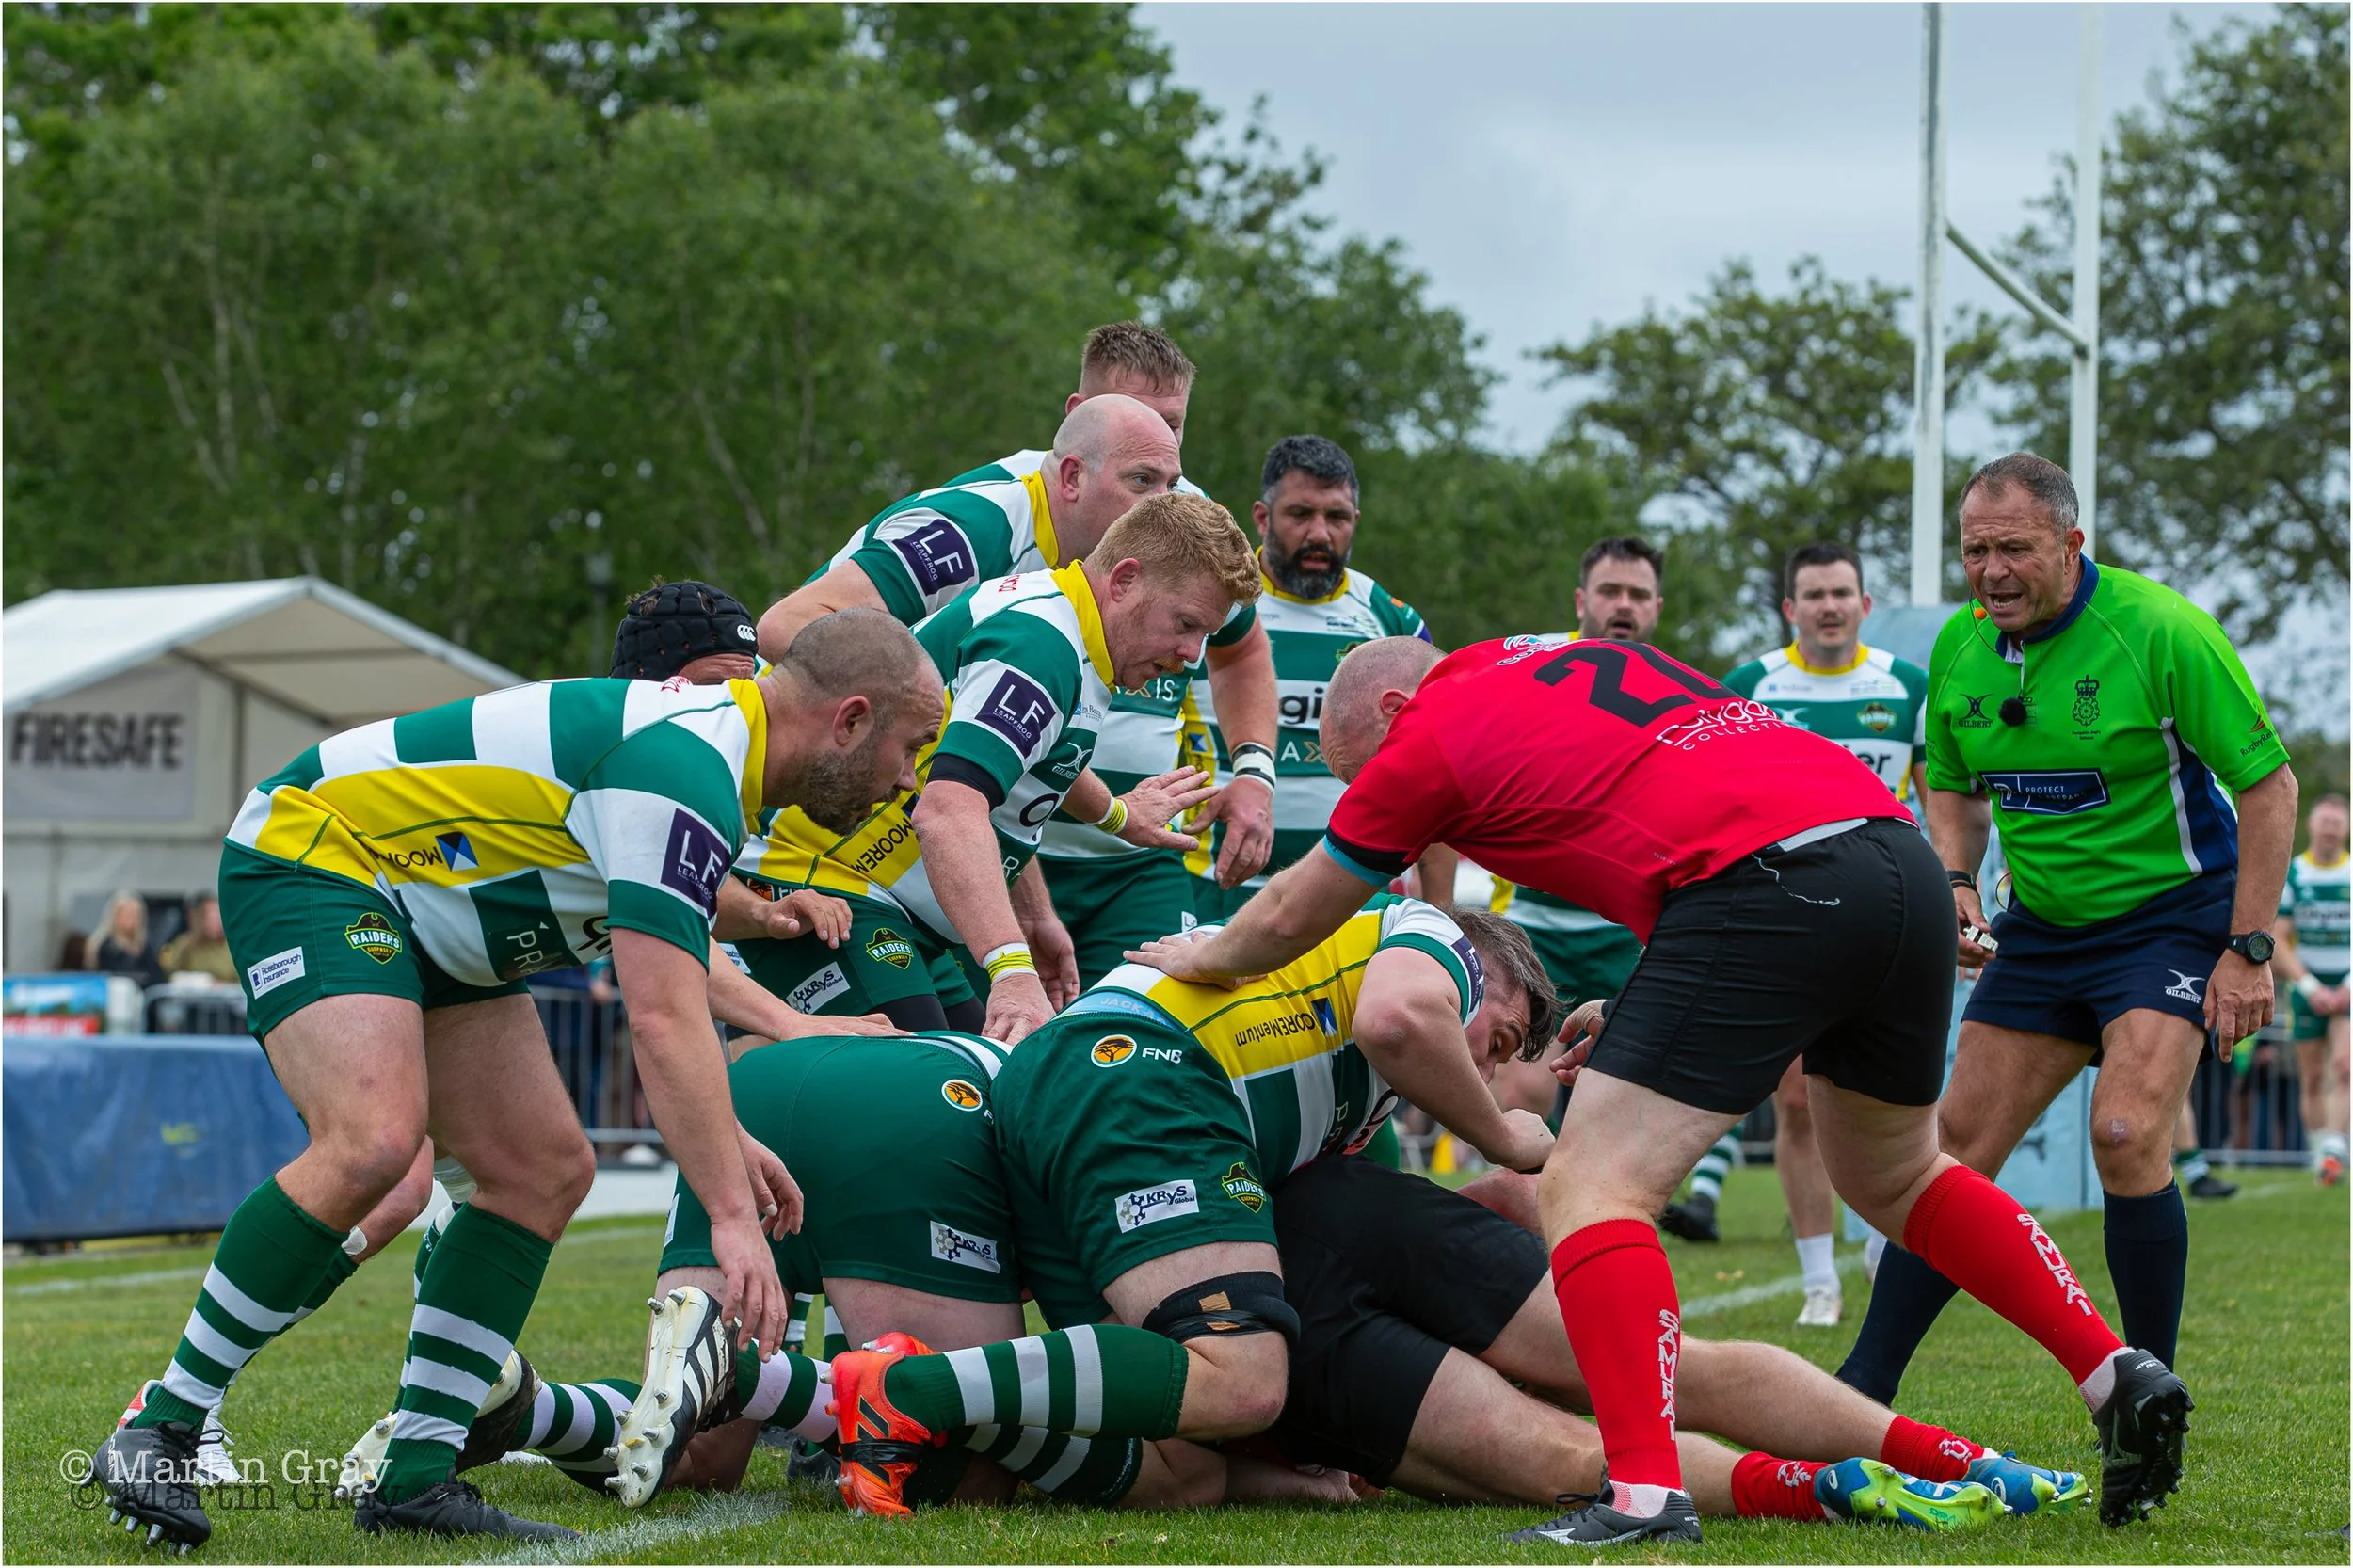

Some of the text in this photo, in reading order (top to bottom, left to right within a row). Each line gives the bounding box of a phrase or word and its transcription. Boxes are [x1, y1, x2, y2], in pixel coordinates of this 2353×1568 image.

[912, 541, 939, 581] LEAPFROG
[998, 684, 1046, 725] LF
[994, 708, 1032, 739] LEAPFROG
[1957, 718, 1993, 728] GILBERT
[11, 712, 185, 771] FIRESAFE
[2025, 785, 2064, 794] PROTECT
[680, 829, 723, 883] LF
[349, 930, 400, 949] RAIDERS
[871, 942, 911, 958] RAIDERS
[262, 953, 302, 975] Rossborough
[264, 968, 290, 984] Insurance
[826, 975, 844, 988] Global
[2166, 988, 2202, 1004] GILBERT
[1142, 1047, 1183, 1064] FNB
[1226, 1180, 1264, 1197] RAIDERS
[1174, 1195, 1195, 1205] Global
[2017, 1213, 2092, 1316] SAMURAI
[1657, 1308, 1680, 1441] SAMURAI
